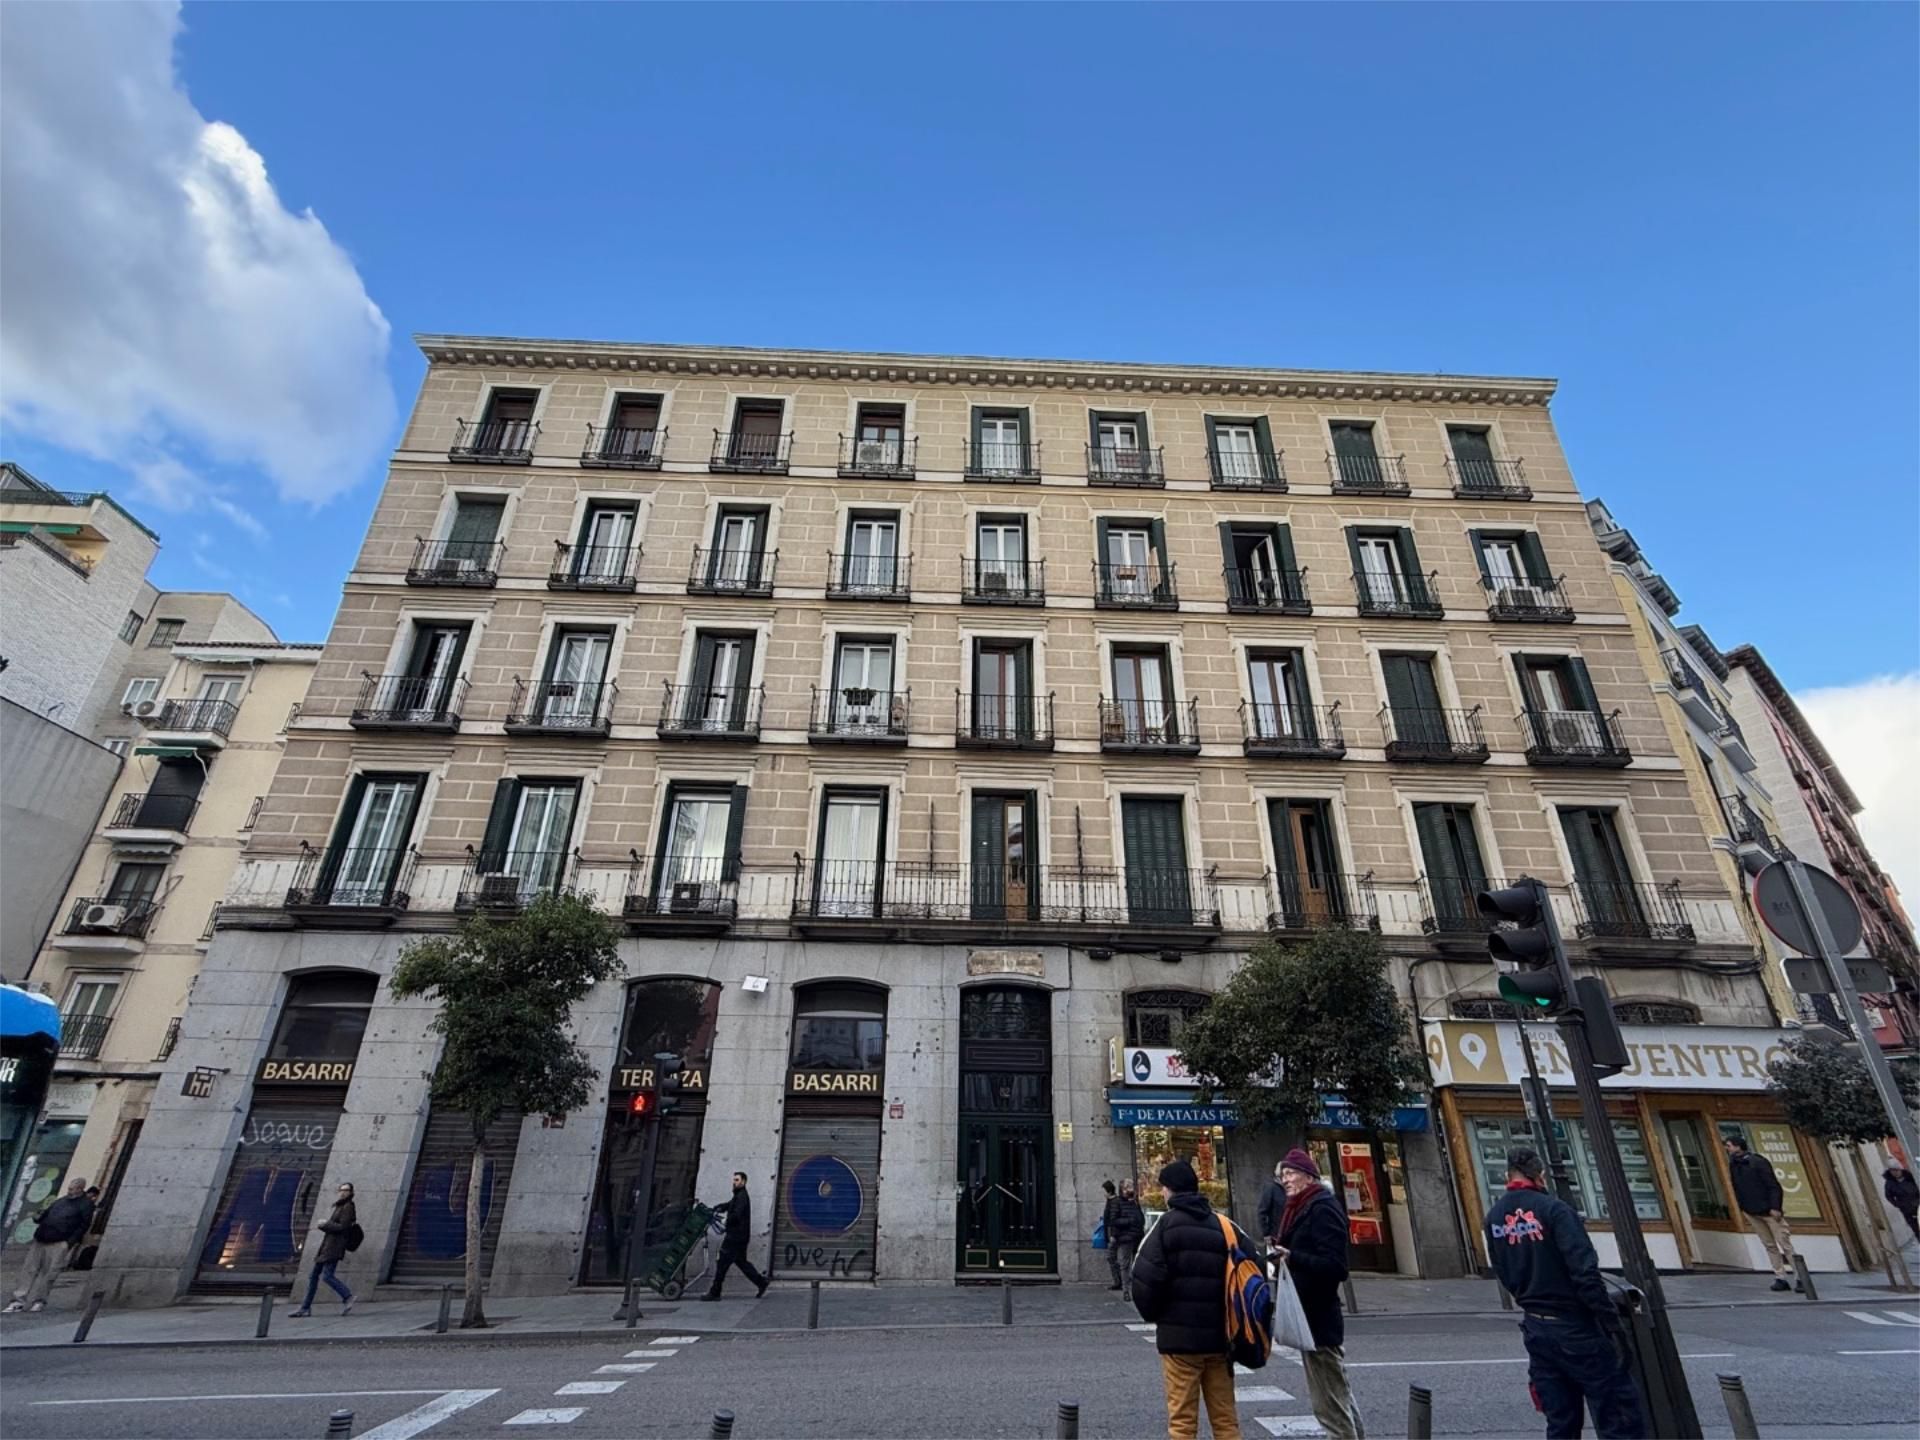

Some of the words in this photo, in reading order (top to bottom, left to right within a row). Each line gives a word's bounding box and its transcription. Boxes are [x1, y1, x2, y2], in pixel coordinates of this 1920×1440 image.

[262, 1063, 352, 1081] BASARRI
[620, 1068, 704, 1088] TERZA
[792, 1073, 878, 1091] BASARRI
[1137, 1109, 1154, 1121] DE
[1157, 1109, 1216, 1121] PATATAS
